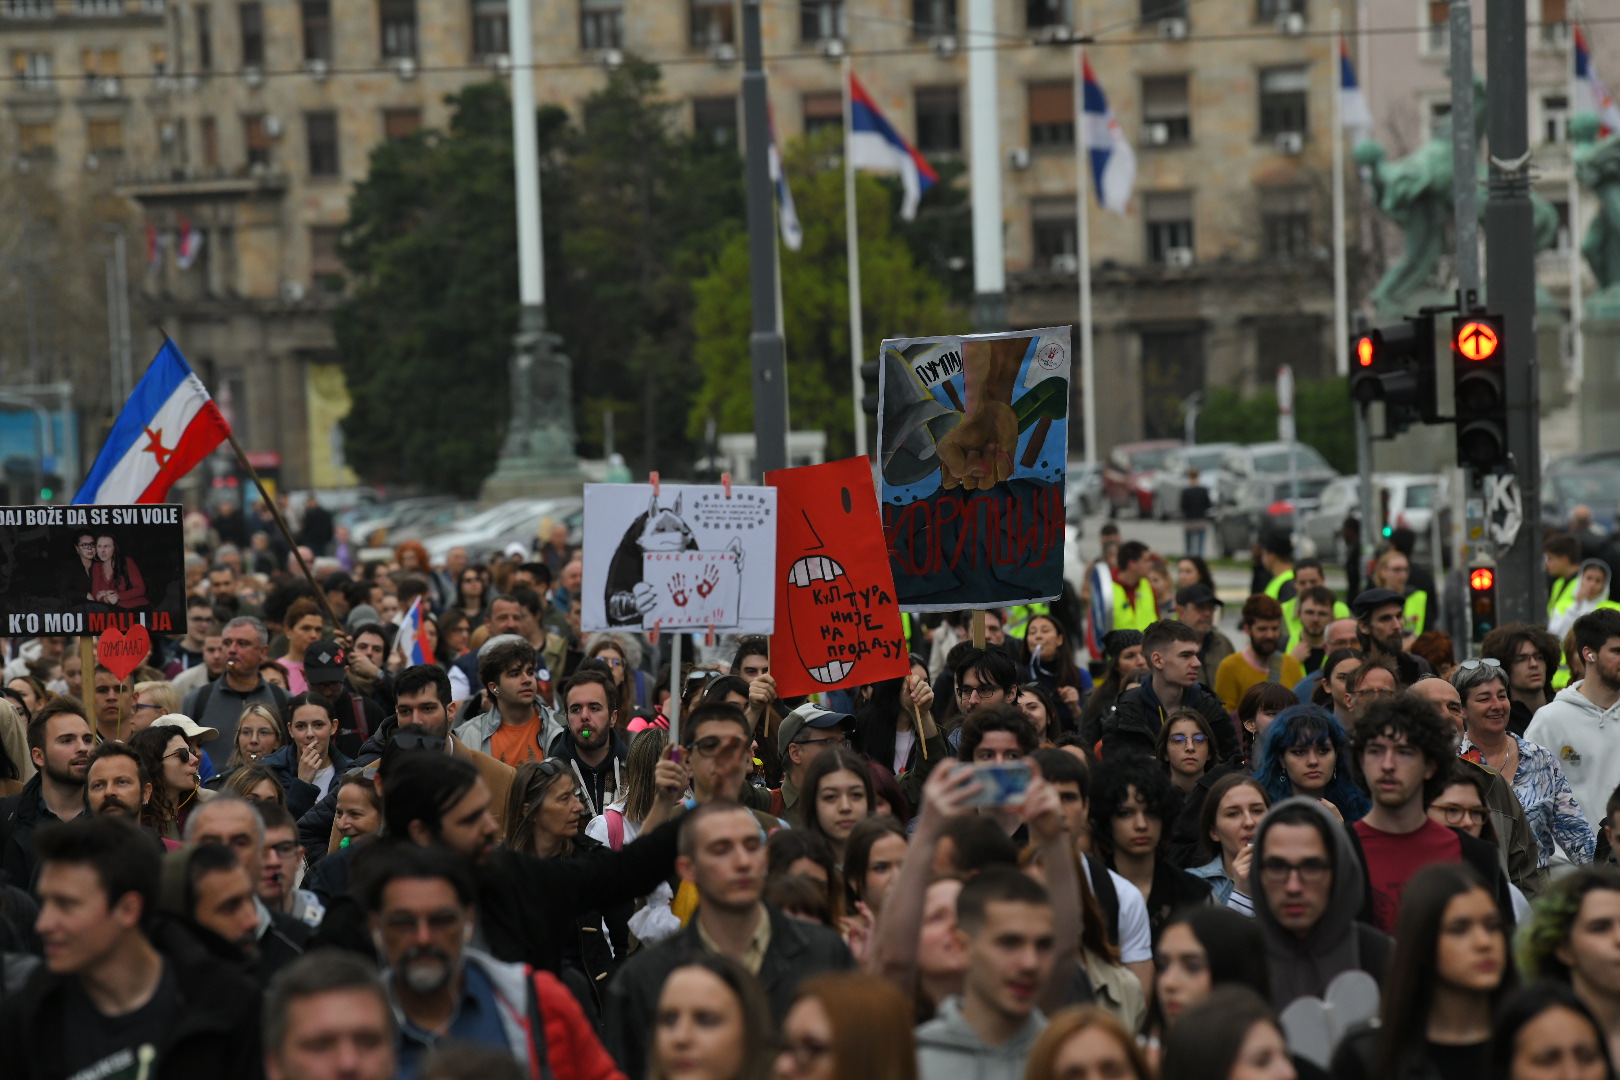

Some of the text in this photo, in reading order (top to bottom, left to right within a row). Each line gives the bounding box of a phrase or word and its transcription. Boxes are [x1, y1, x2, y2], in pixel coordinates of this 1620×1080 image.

[25, 506, 63, 526] BOŽE
[66, 509, 88, 525] DA
[90, 508, 109, 525] SE
[112, 508, 138, 524] SVI
[141, 508, 178, 524] VOLE
[885, 484, 1065, 576] КОРУПЦИЈА
[44, 612, 83, 633] MOJ
[88, 612, 134, 632] MALI
[139, 612, 146, 627] I
[151, 611, 173, 631] JA
[819, 625, 844, 641] НА
